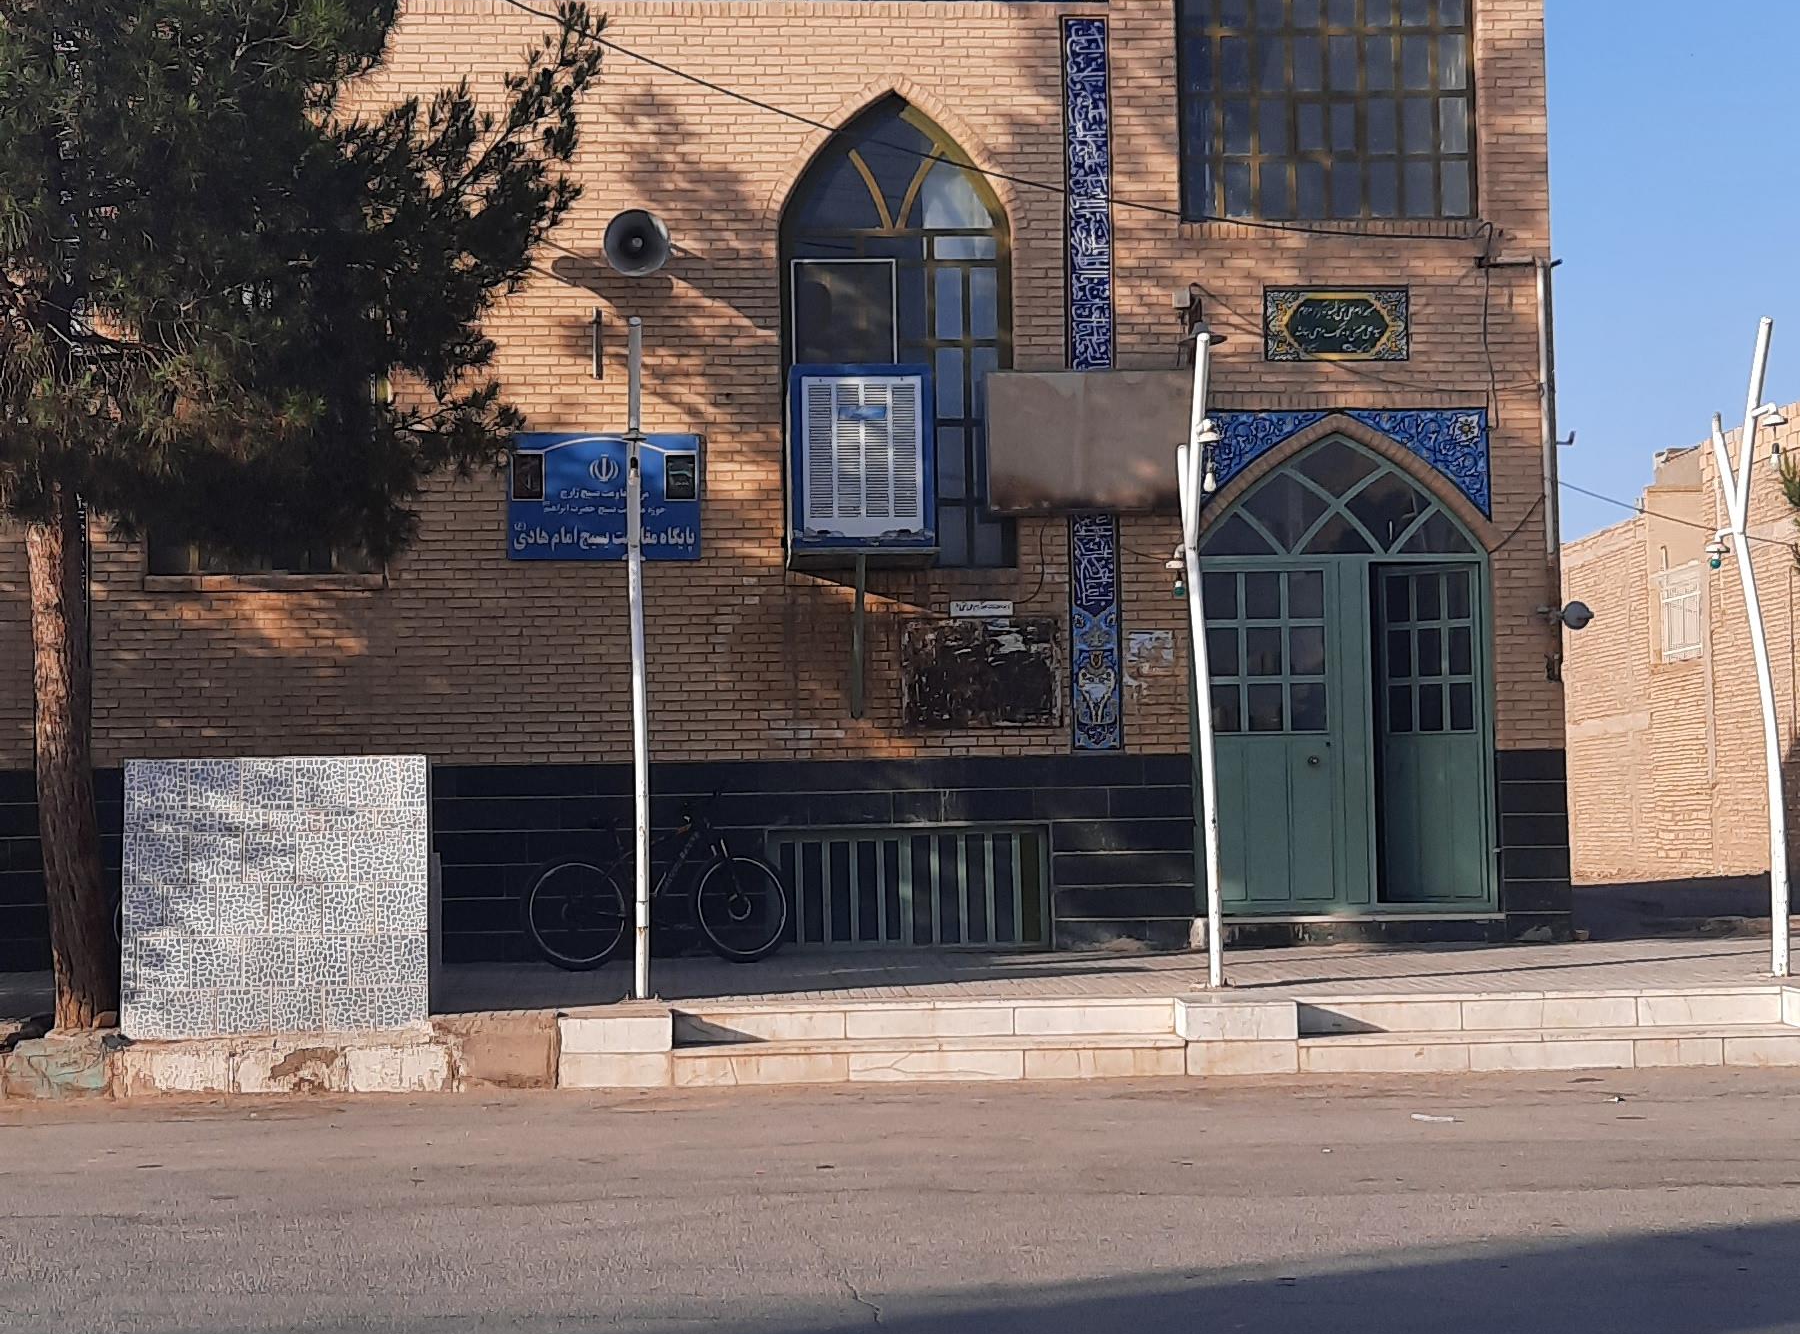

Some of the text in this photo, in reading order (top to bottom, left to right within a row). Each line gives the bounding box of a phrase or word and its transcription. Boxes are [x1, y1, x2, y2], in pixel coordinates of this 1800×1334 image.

[513, 526, 549, 550] هادی
[551, 524, 578, 552] امام
[579, 531, 609, 550] بسیج
[659, 526, 695, 554] پایگاه
